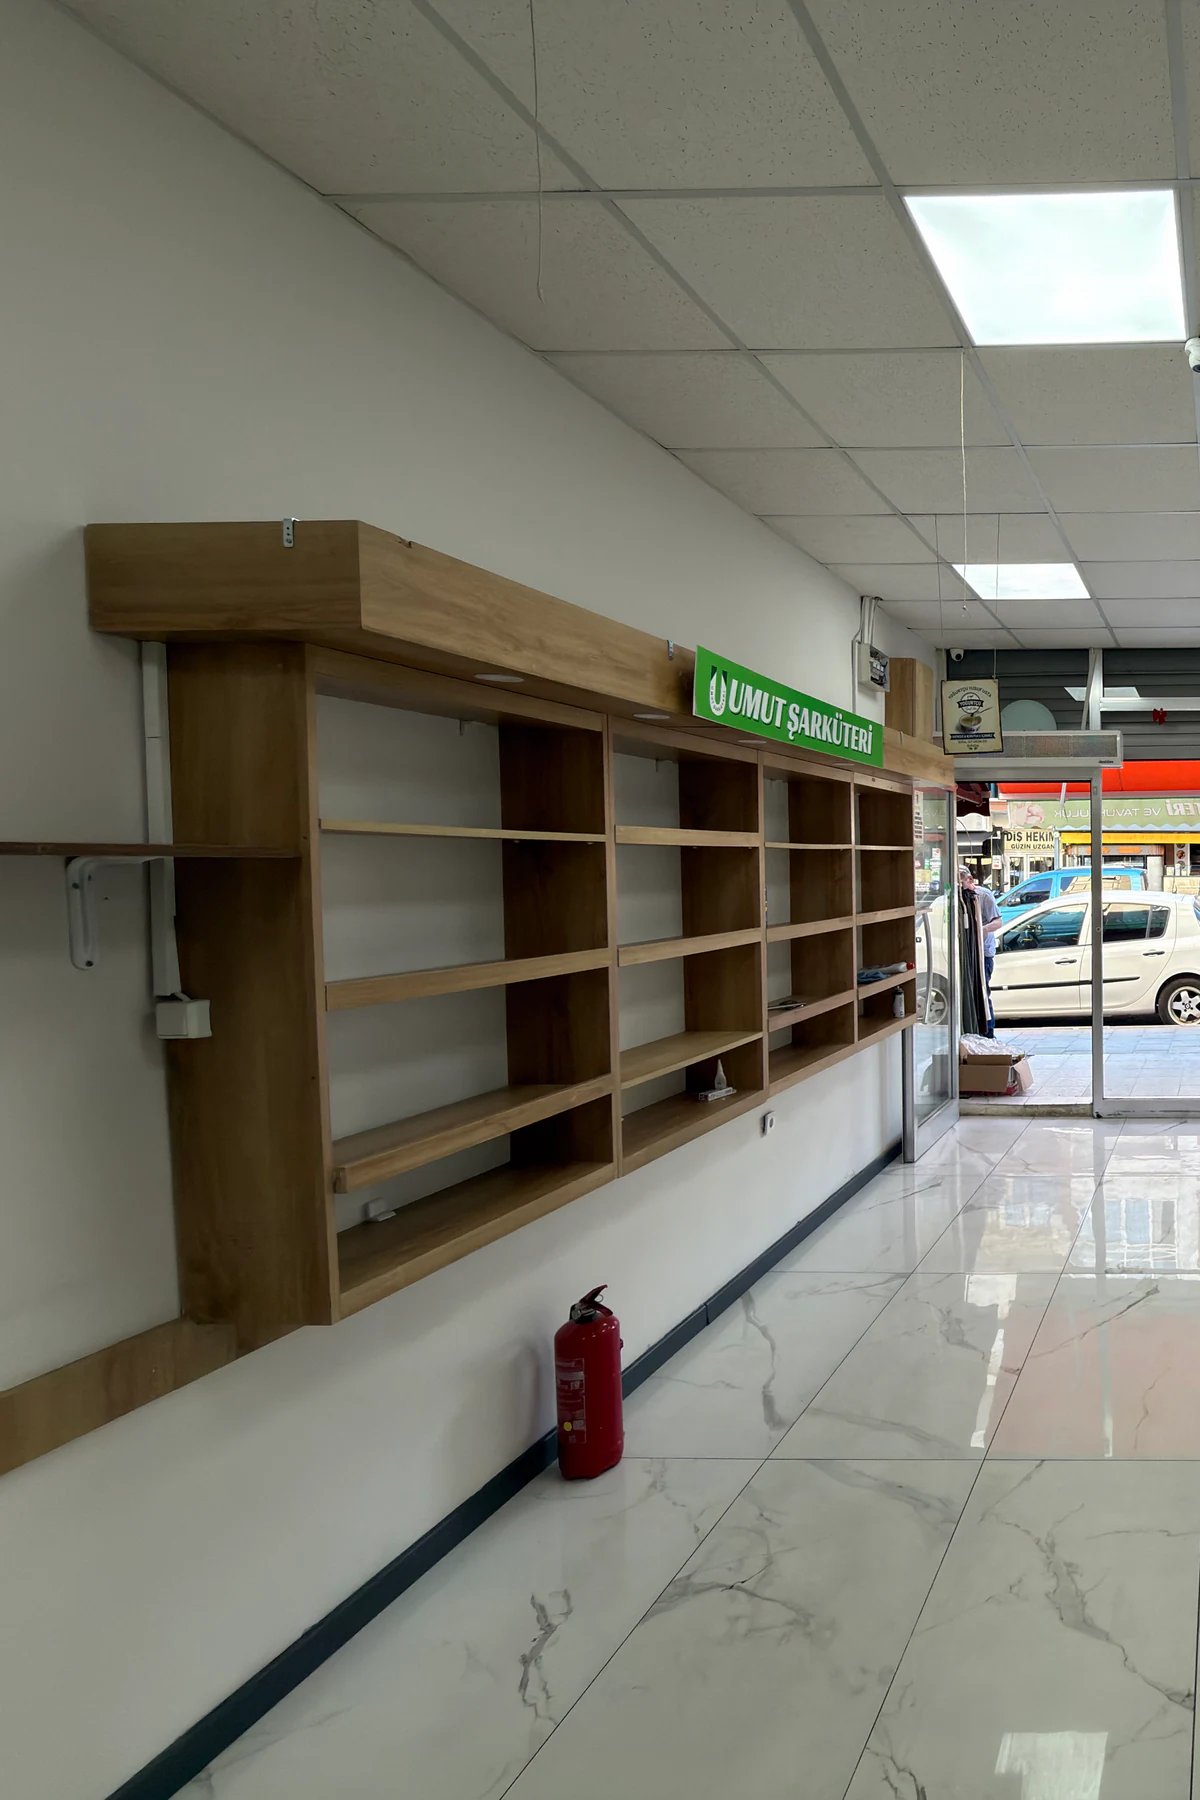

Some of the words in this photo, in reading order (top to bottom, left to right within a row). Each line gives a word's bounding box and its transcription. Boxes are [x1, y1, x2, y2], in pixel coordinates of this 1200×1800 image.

[728, 679, 787, 730] UMUT
[787, 703, 873, 755] ŞARKÜTERİ
[1006, 831, 1023, 842] DİŞ
